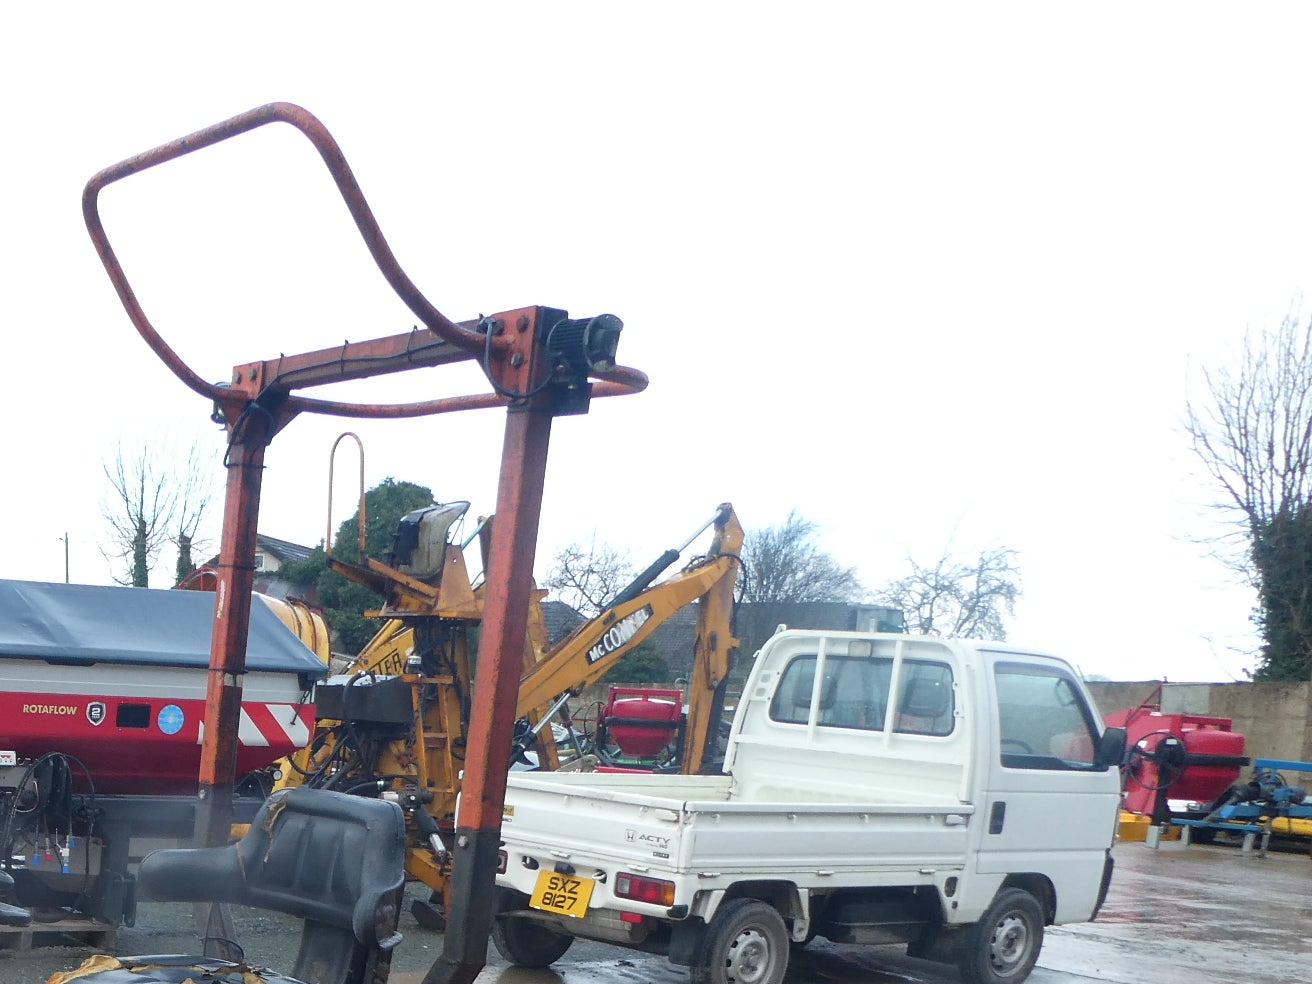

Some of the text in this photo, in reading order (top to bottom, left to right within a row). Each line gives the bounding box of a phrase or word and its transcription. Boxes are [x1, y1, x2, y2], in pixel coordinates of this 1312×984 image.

[22, 704, 78, 715] ROTAFLOW
[91, 707, 101, 716] 2
[638, 834, 671, 844] ACTY
[547, 877, 581, 895] SXZ
[541, 892, 578, 911] 8127
